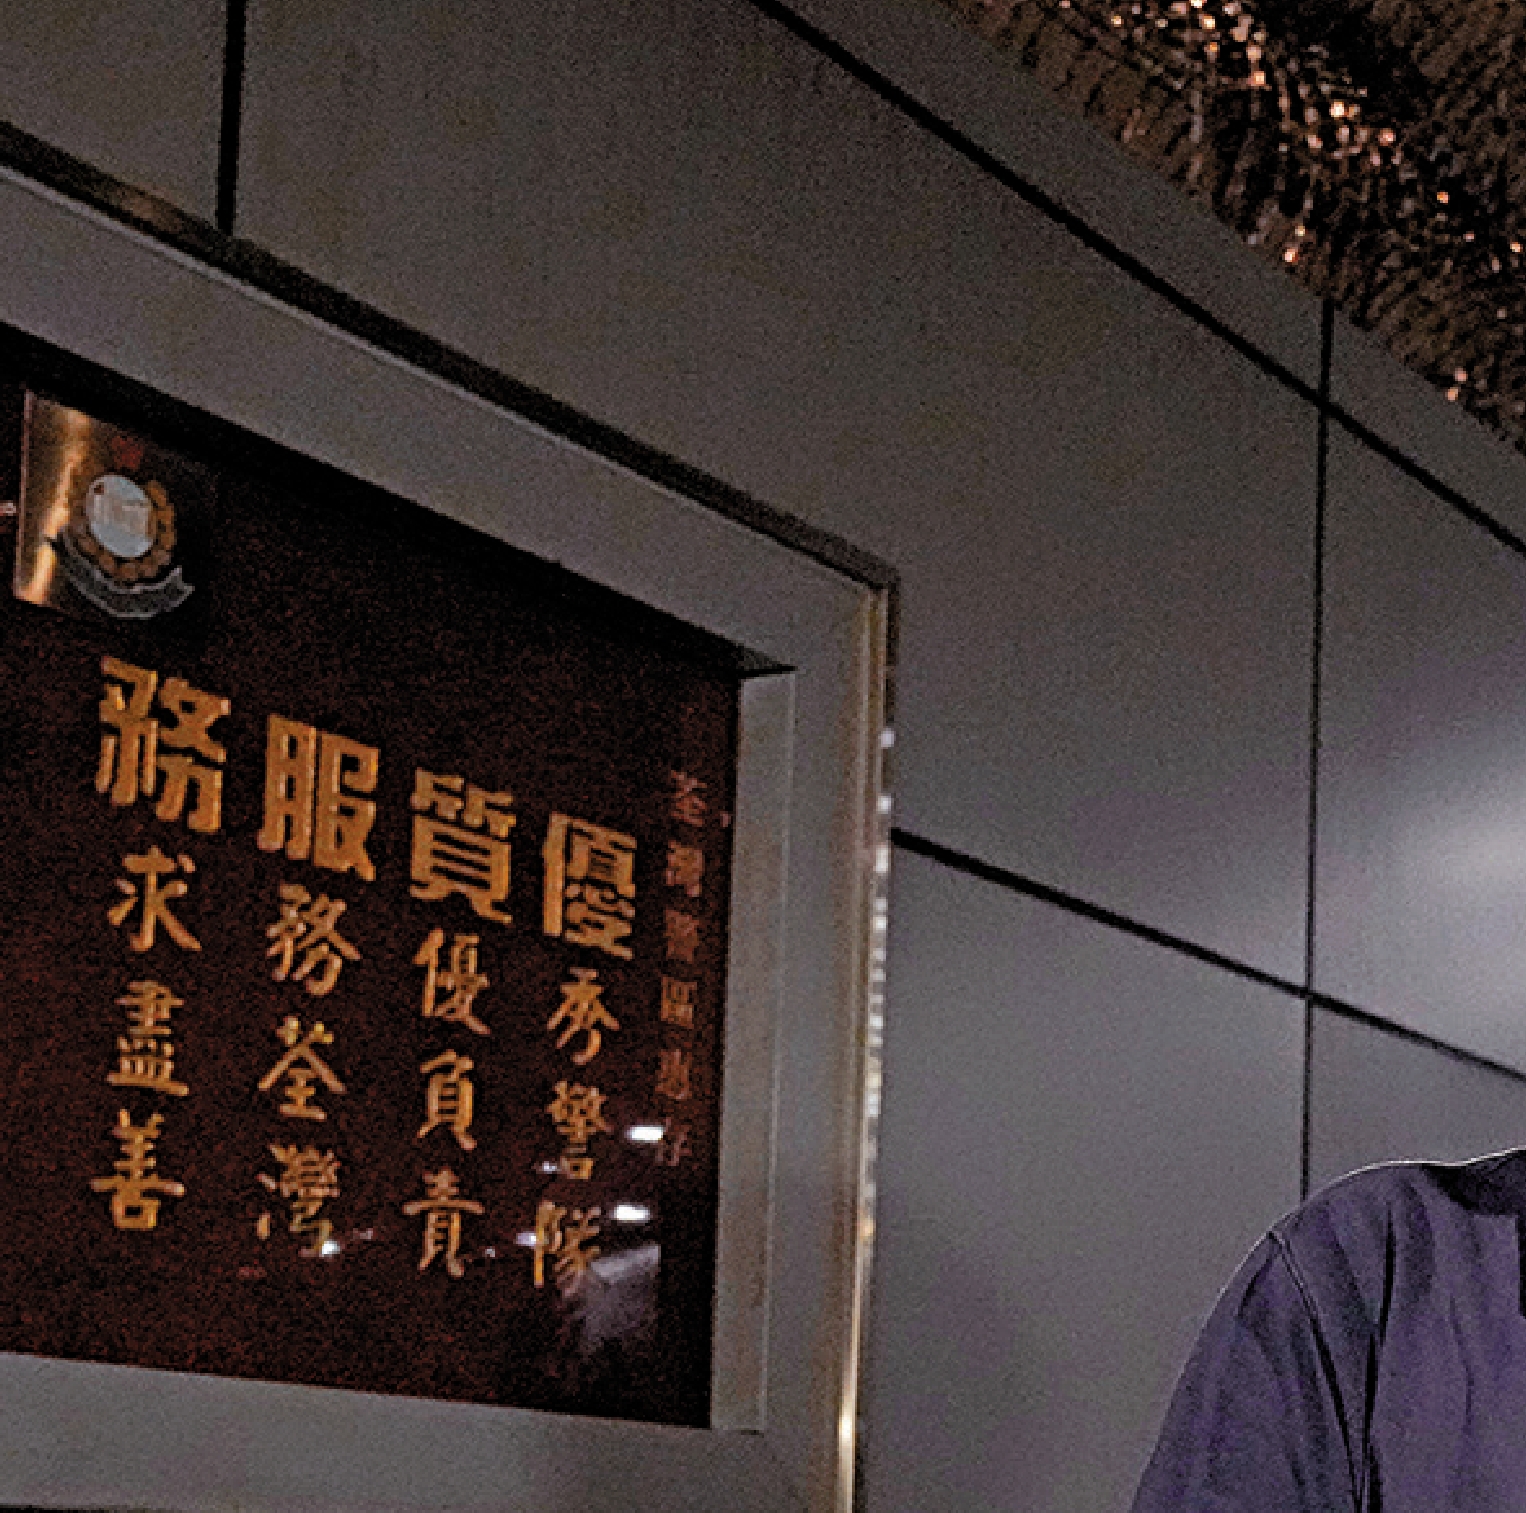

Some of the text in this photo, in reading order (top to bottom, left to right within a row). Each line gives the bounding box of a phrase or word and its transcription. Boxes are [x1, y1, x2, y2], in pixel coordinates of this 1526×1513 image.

[91, 655, 232, 1232] 務求盡善
[257, 714, 380, 1257] 服務荃灣
[402, 766, 517, 1278] 質優負責
[533, 811, 637, 1299] 優秀警隊
